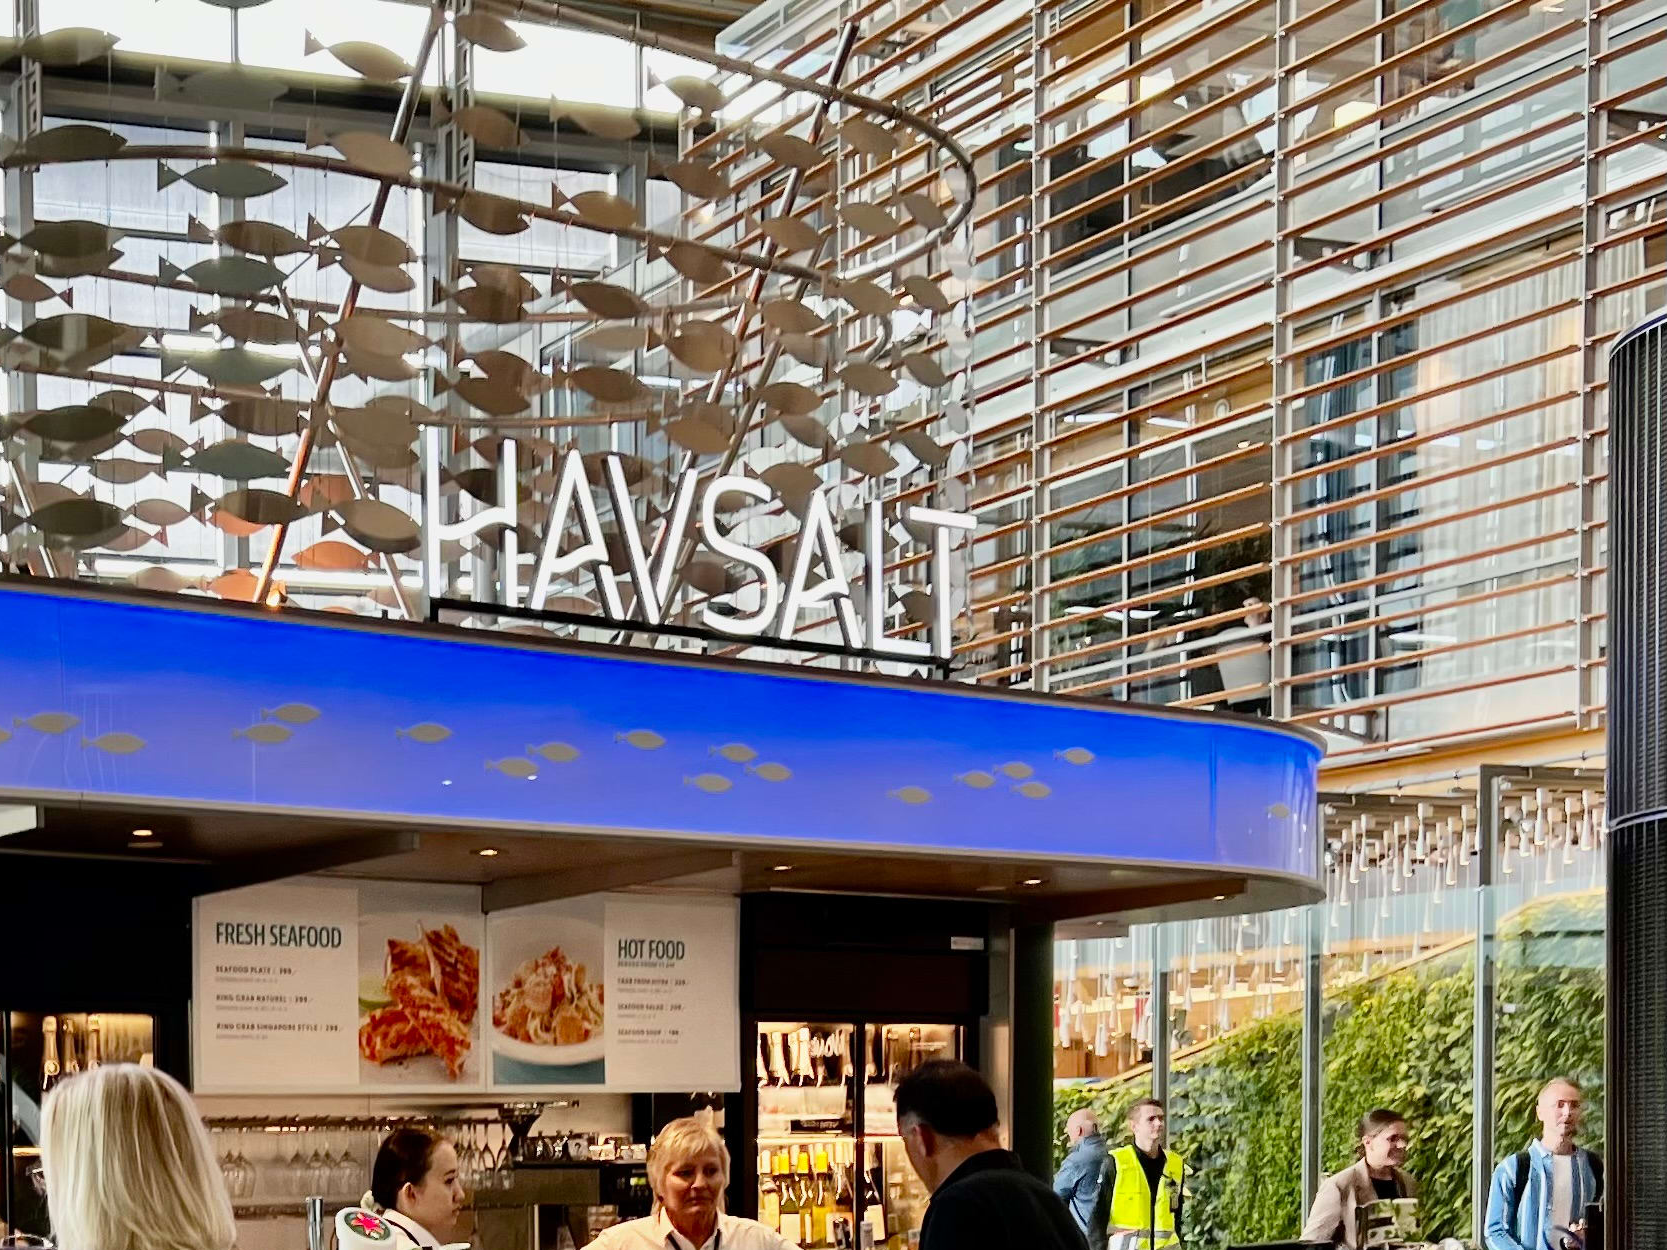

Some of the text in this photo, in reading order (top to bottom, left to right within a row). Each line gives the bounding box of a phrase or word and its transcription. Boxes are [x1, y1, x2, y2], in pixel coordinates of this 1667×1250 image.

[423, 426, 978, 660] HAVSALT
[215, 921, 343, 949] FRESH SEAFOOD
[617, 938, 686, 961] HOT FOOD
